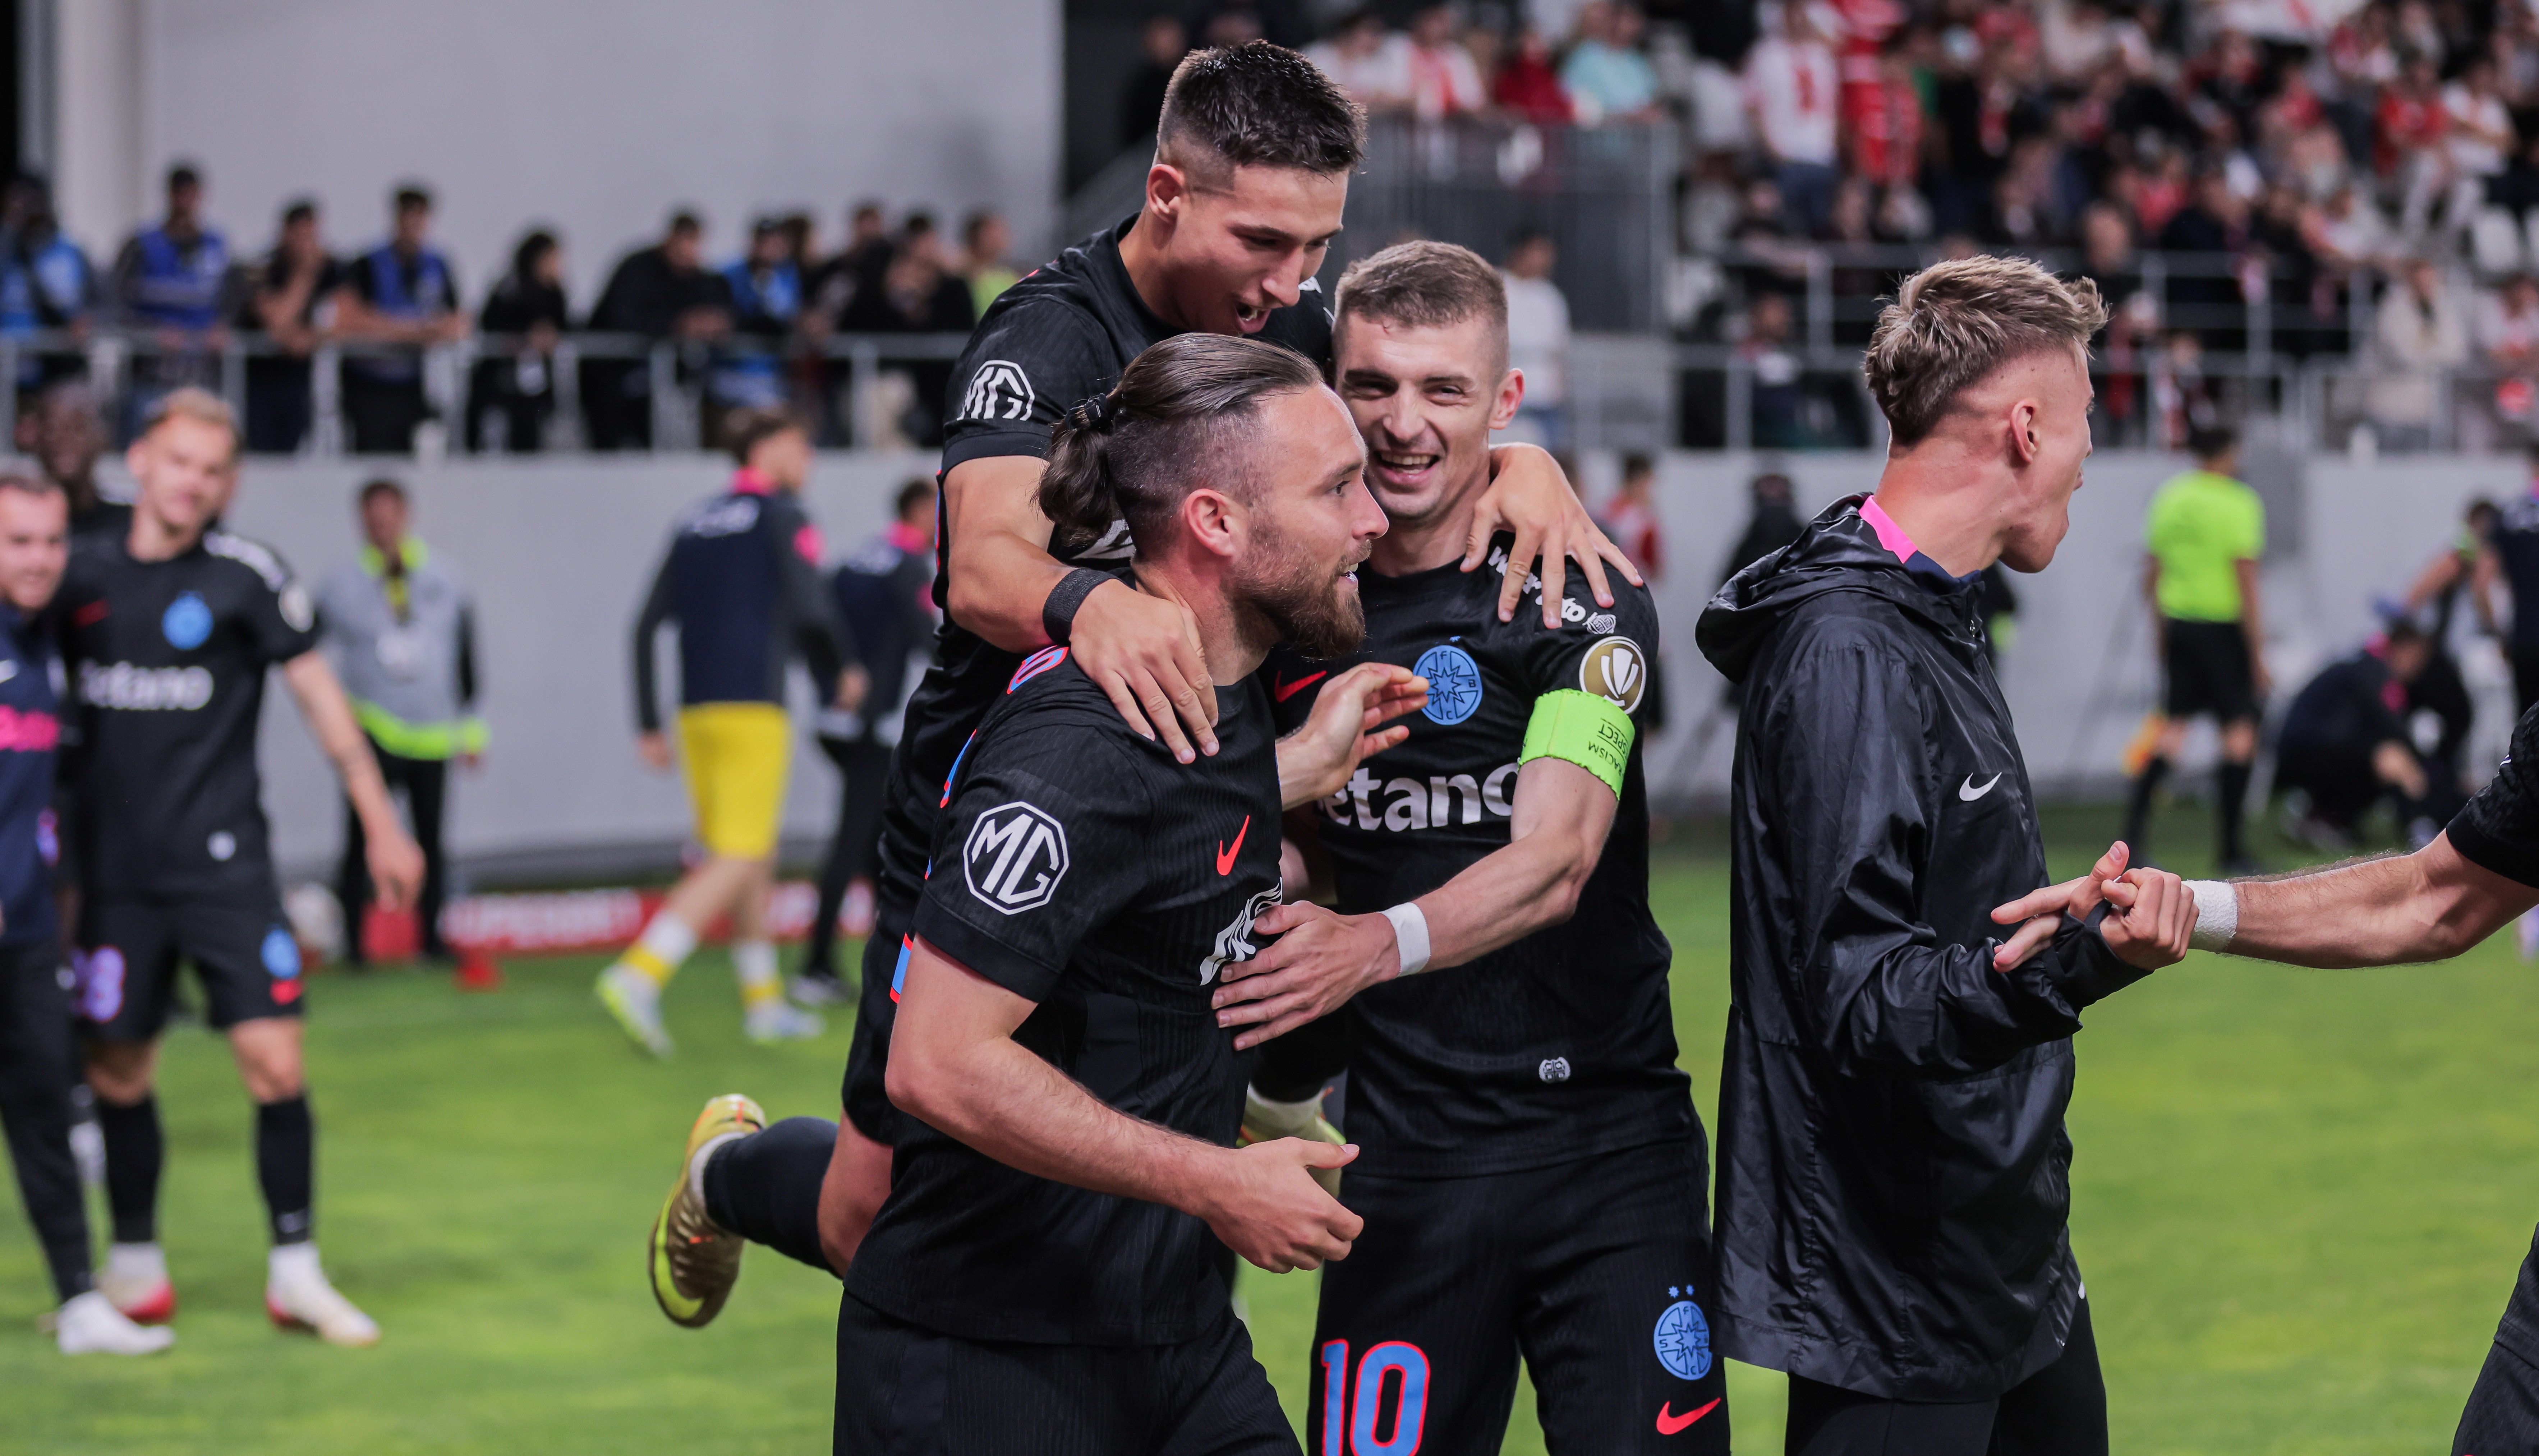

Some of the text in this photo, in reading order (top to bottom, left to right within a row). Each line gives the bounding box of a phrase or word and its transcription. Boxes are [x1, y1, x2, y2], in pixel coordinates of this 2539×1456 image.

[965, 366, 1025, 420] MG
[1598, 724, 1627, 755] SPECT
[1317, 762, 1519, 832] etano
[971, 813, 1059, 904] MG
[1321, 1338, 1431, 1456] 10
